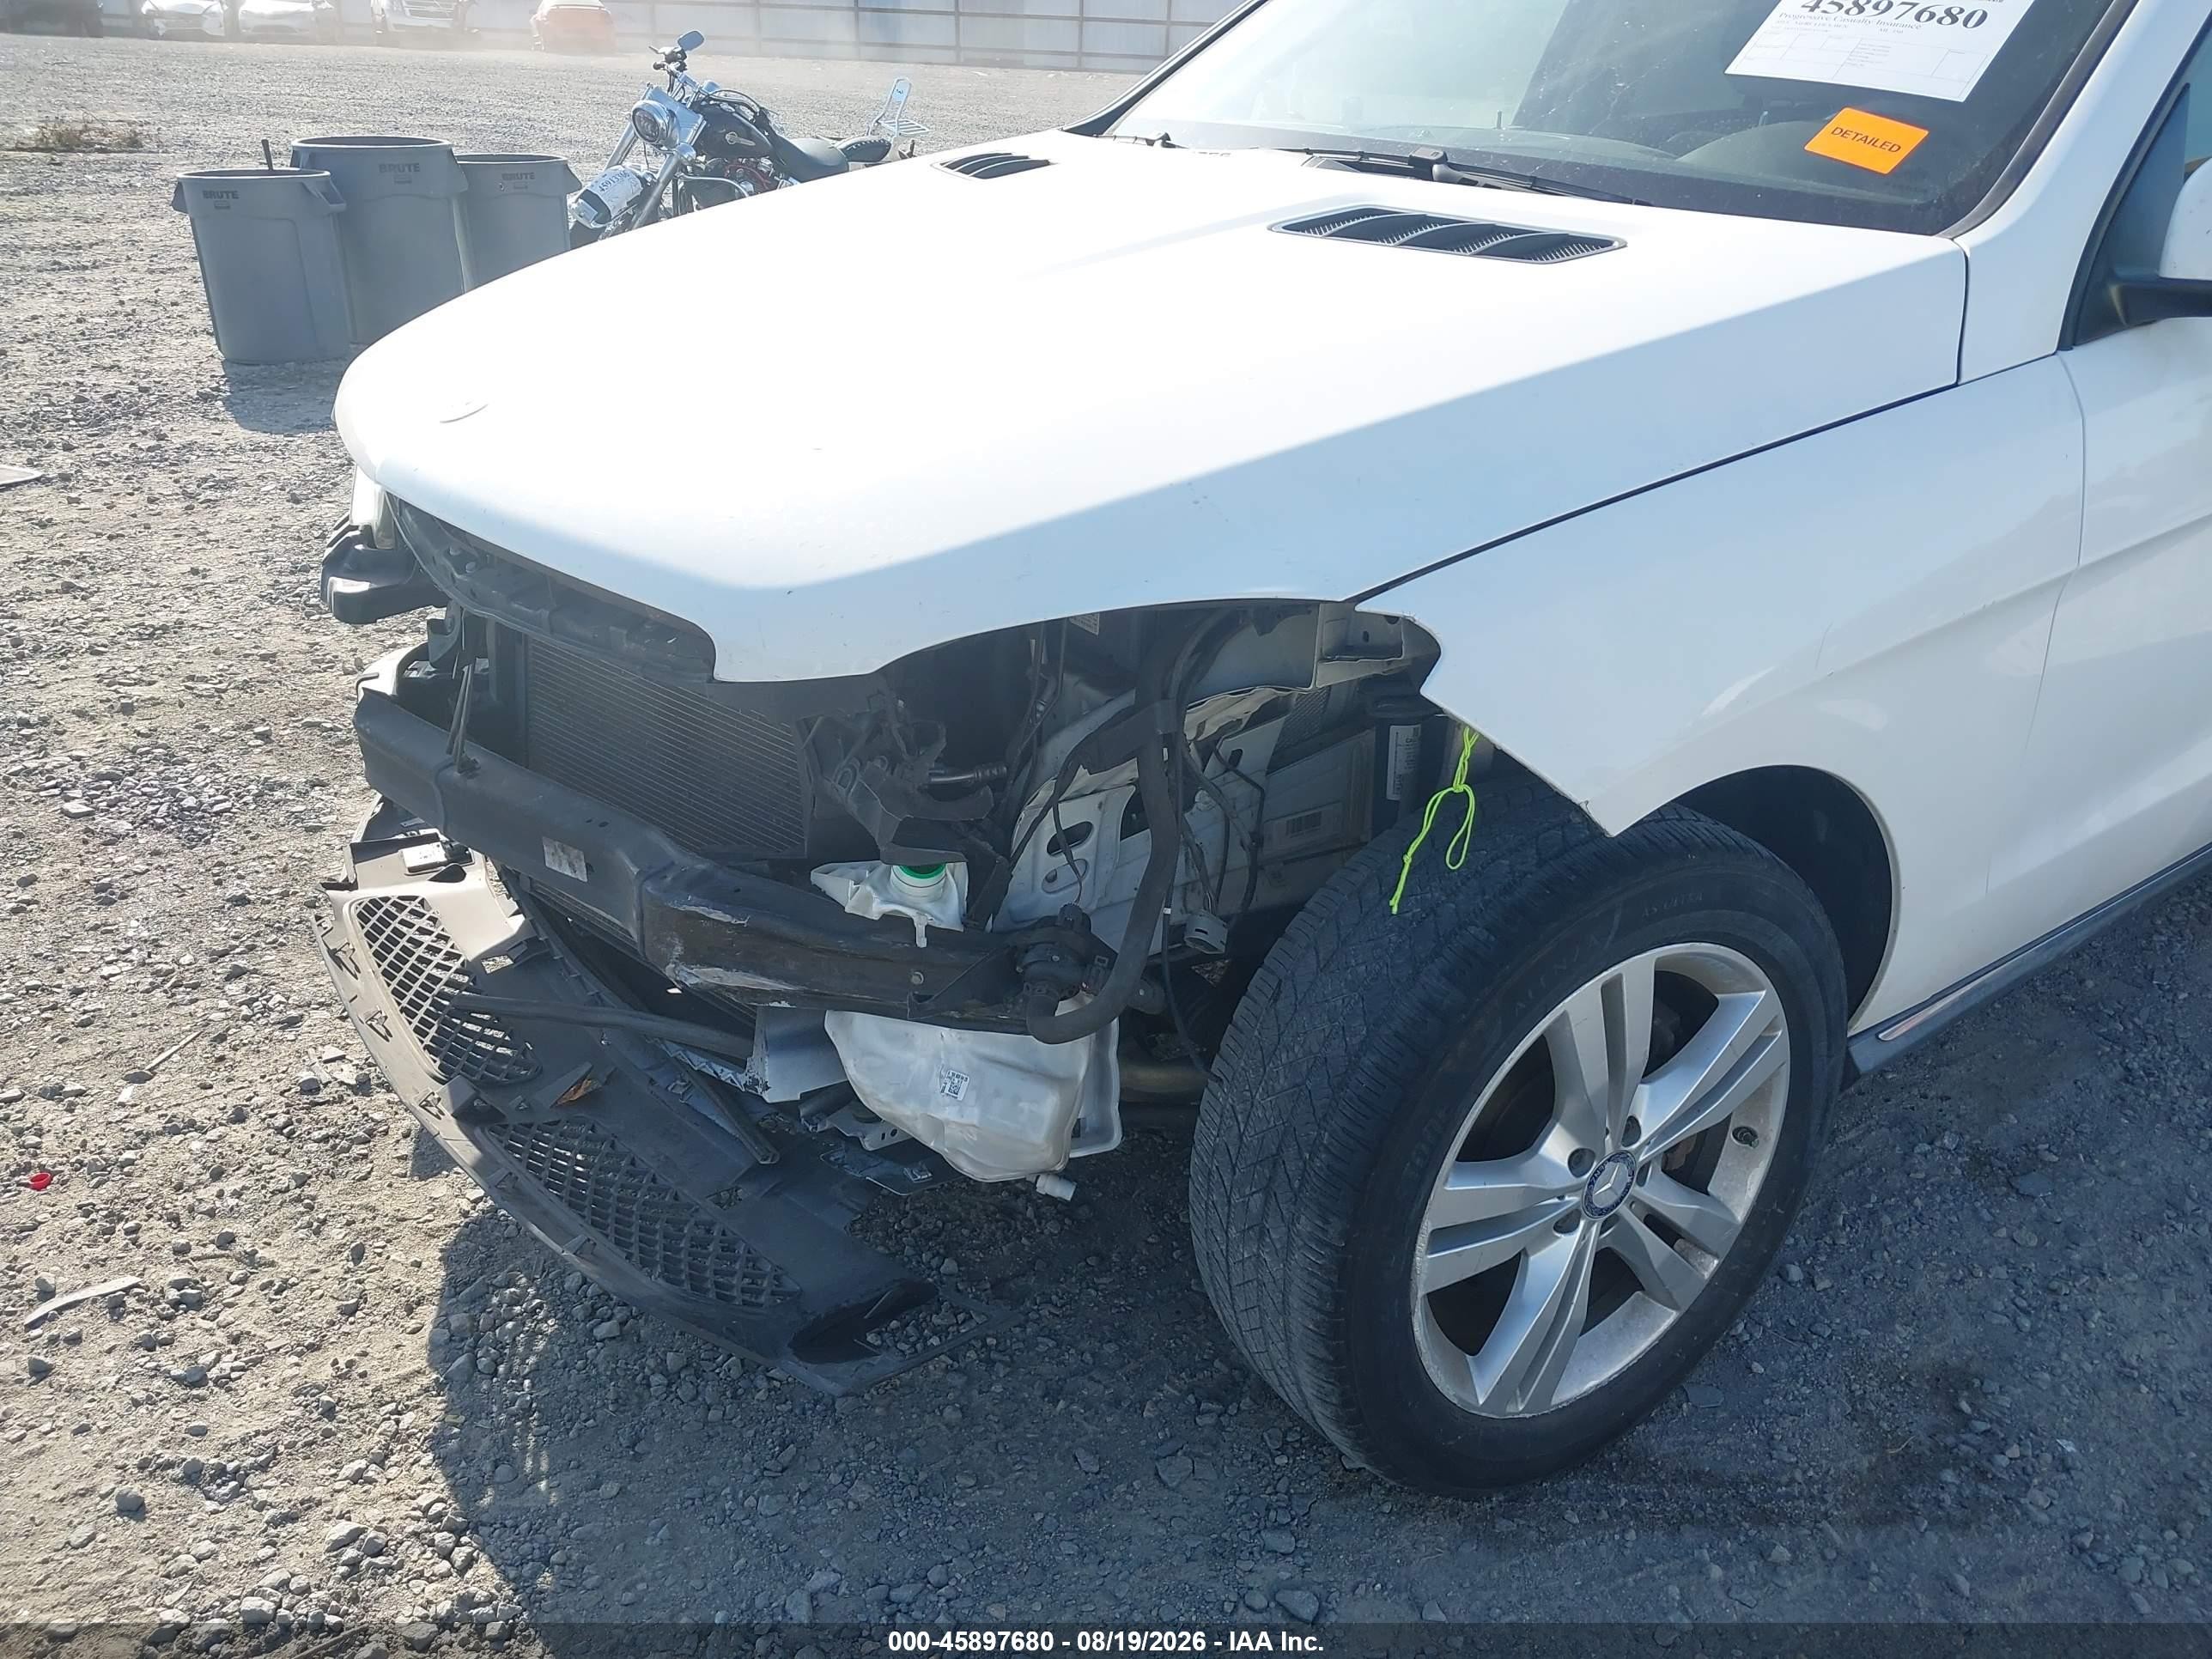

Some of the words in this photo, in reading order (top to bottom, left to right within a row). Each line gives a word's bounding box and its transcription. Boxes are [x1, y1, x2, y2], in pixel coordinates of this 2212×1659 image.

[1801, 0, 1989, 29] 45897680
[1875, 19, 1923, 29] Insurance
[1831, 126, 1901, 153] DETAILED
[378, 162, 421, 173] BRUTE
[501, 172, 536, 181] BRUTE
[202, 190, 240, 199] BRUTE
